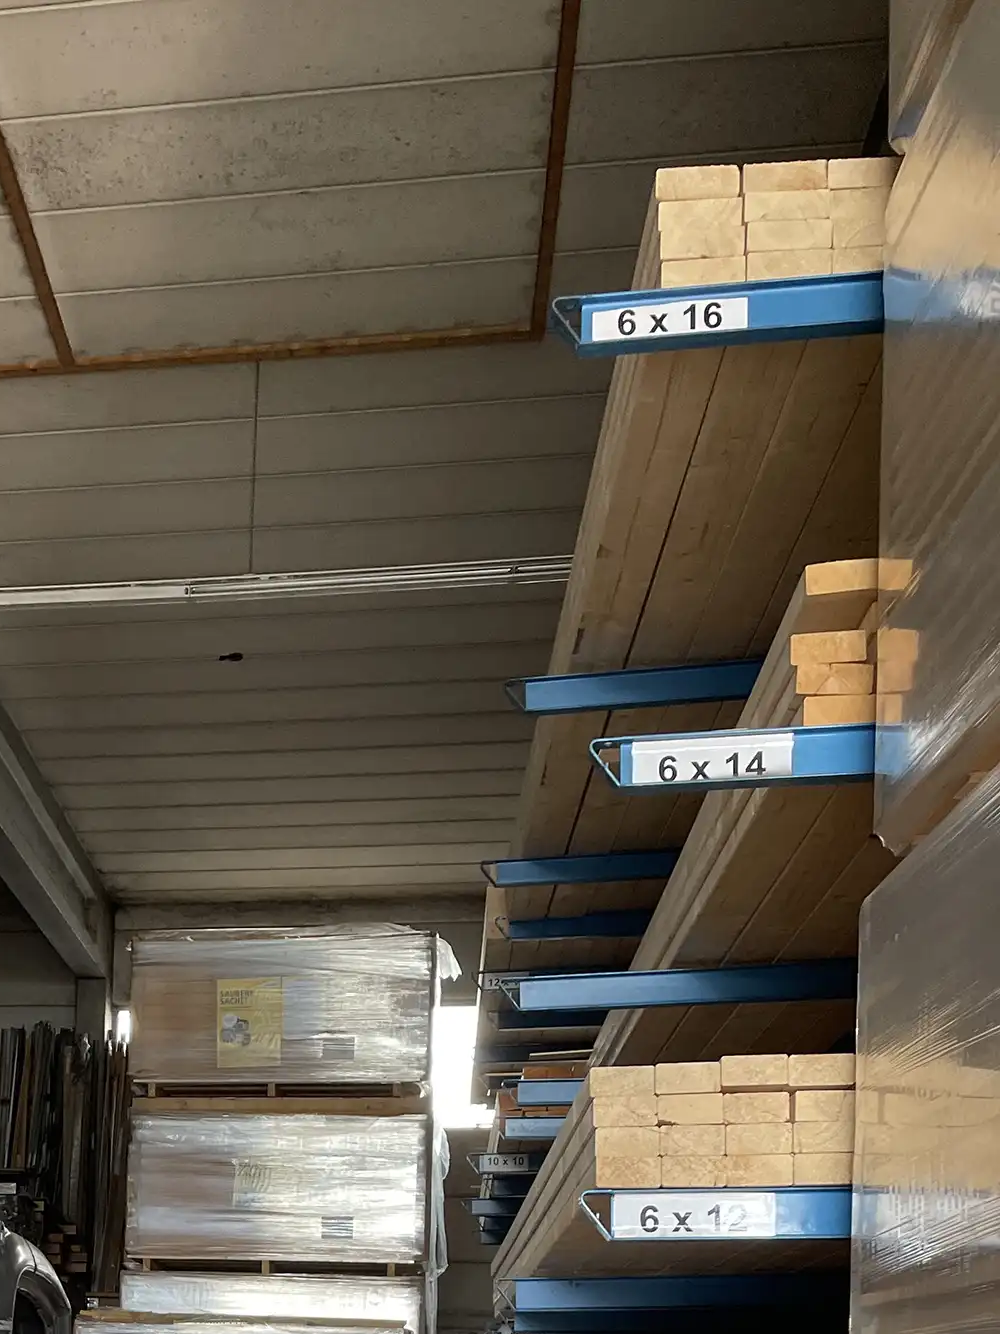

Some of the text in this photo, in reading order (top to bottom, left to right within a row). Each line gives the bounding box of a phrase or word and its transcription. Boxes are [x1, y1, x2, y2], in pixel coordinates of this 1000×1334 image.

[618, 302, 722, 336] 6 x 16
[659, 751, 766, 782] 6 x 14
[488, 1156, 499, 1166] 10
[513, 1156, 524, 1166] 10
[640, 1203, 748, 1233] 6 x 12
